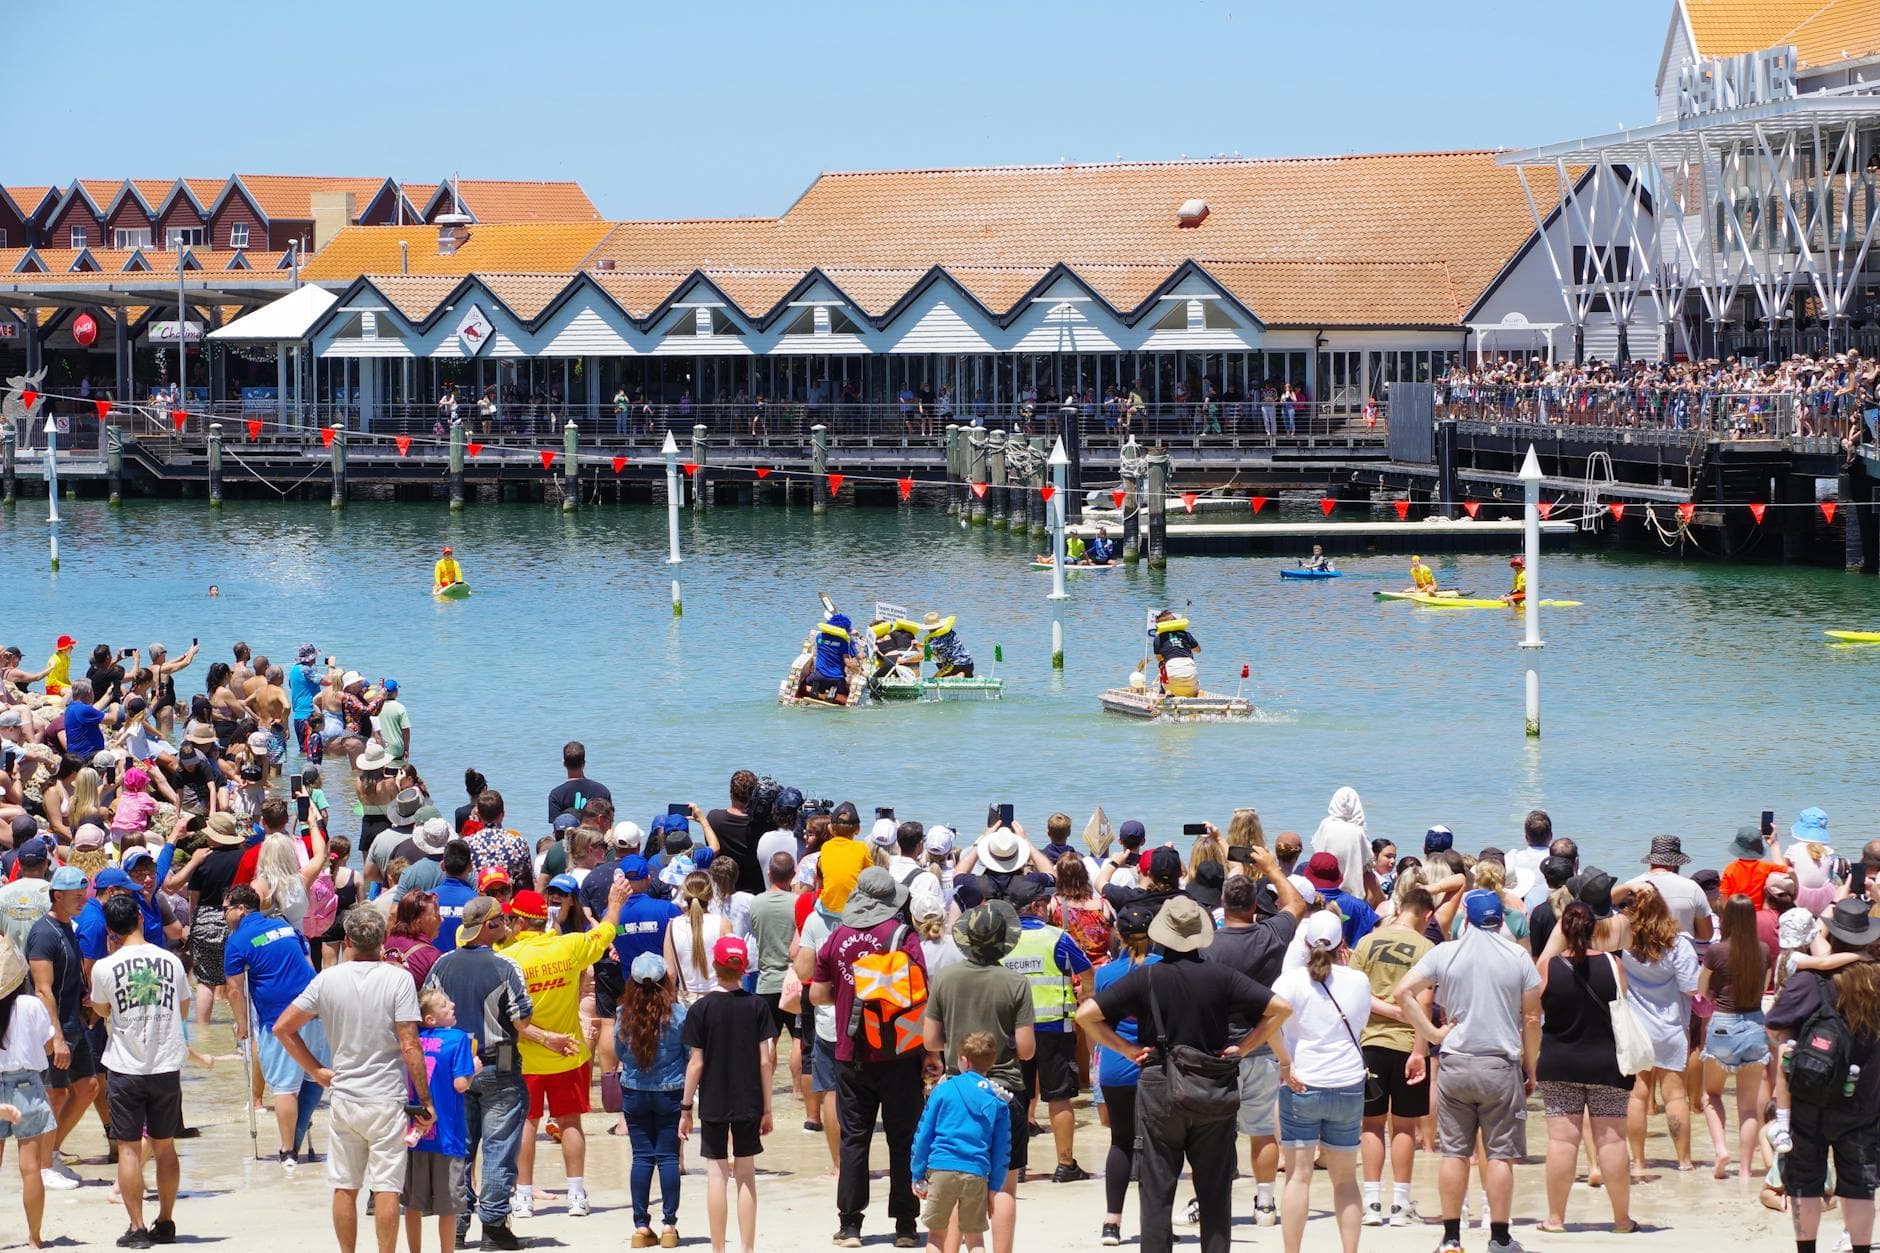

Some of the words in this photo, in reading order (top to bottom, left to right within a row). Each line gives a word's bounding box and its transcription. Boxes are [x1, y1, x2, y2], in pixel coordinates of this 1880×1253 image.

[112, 957, 174, 988] PISMO
[523, 967, 540, 980] URF
[542, 959, 573, 976] RESCUE
[1005, 959, 1042, 970] SECURITY
[528, 978, 567, 993] DHL
